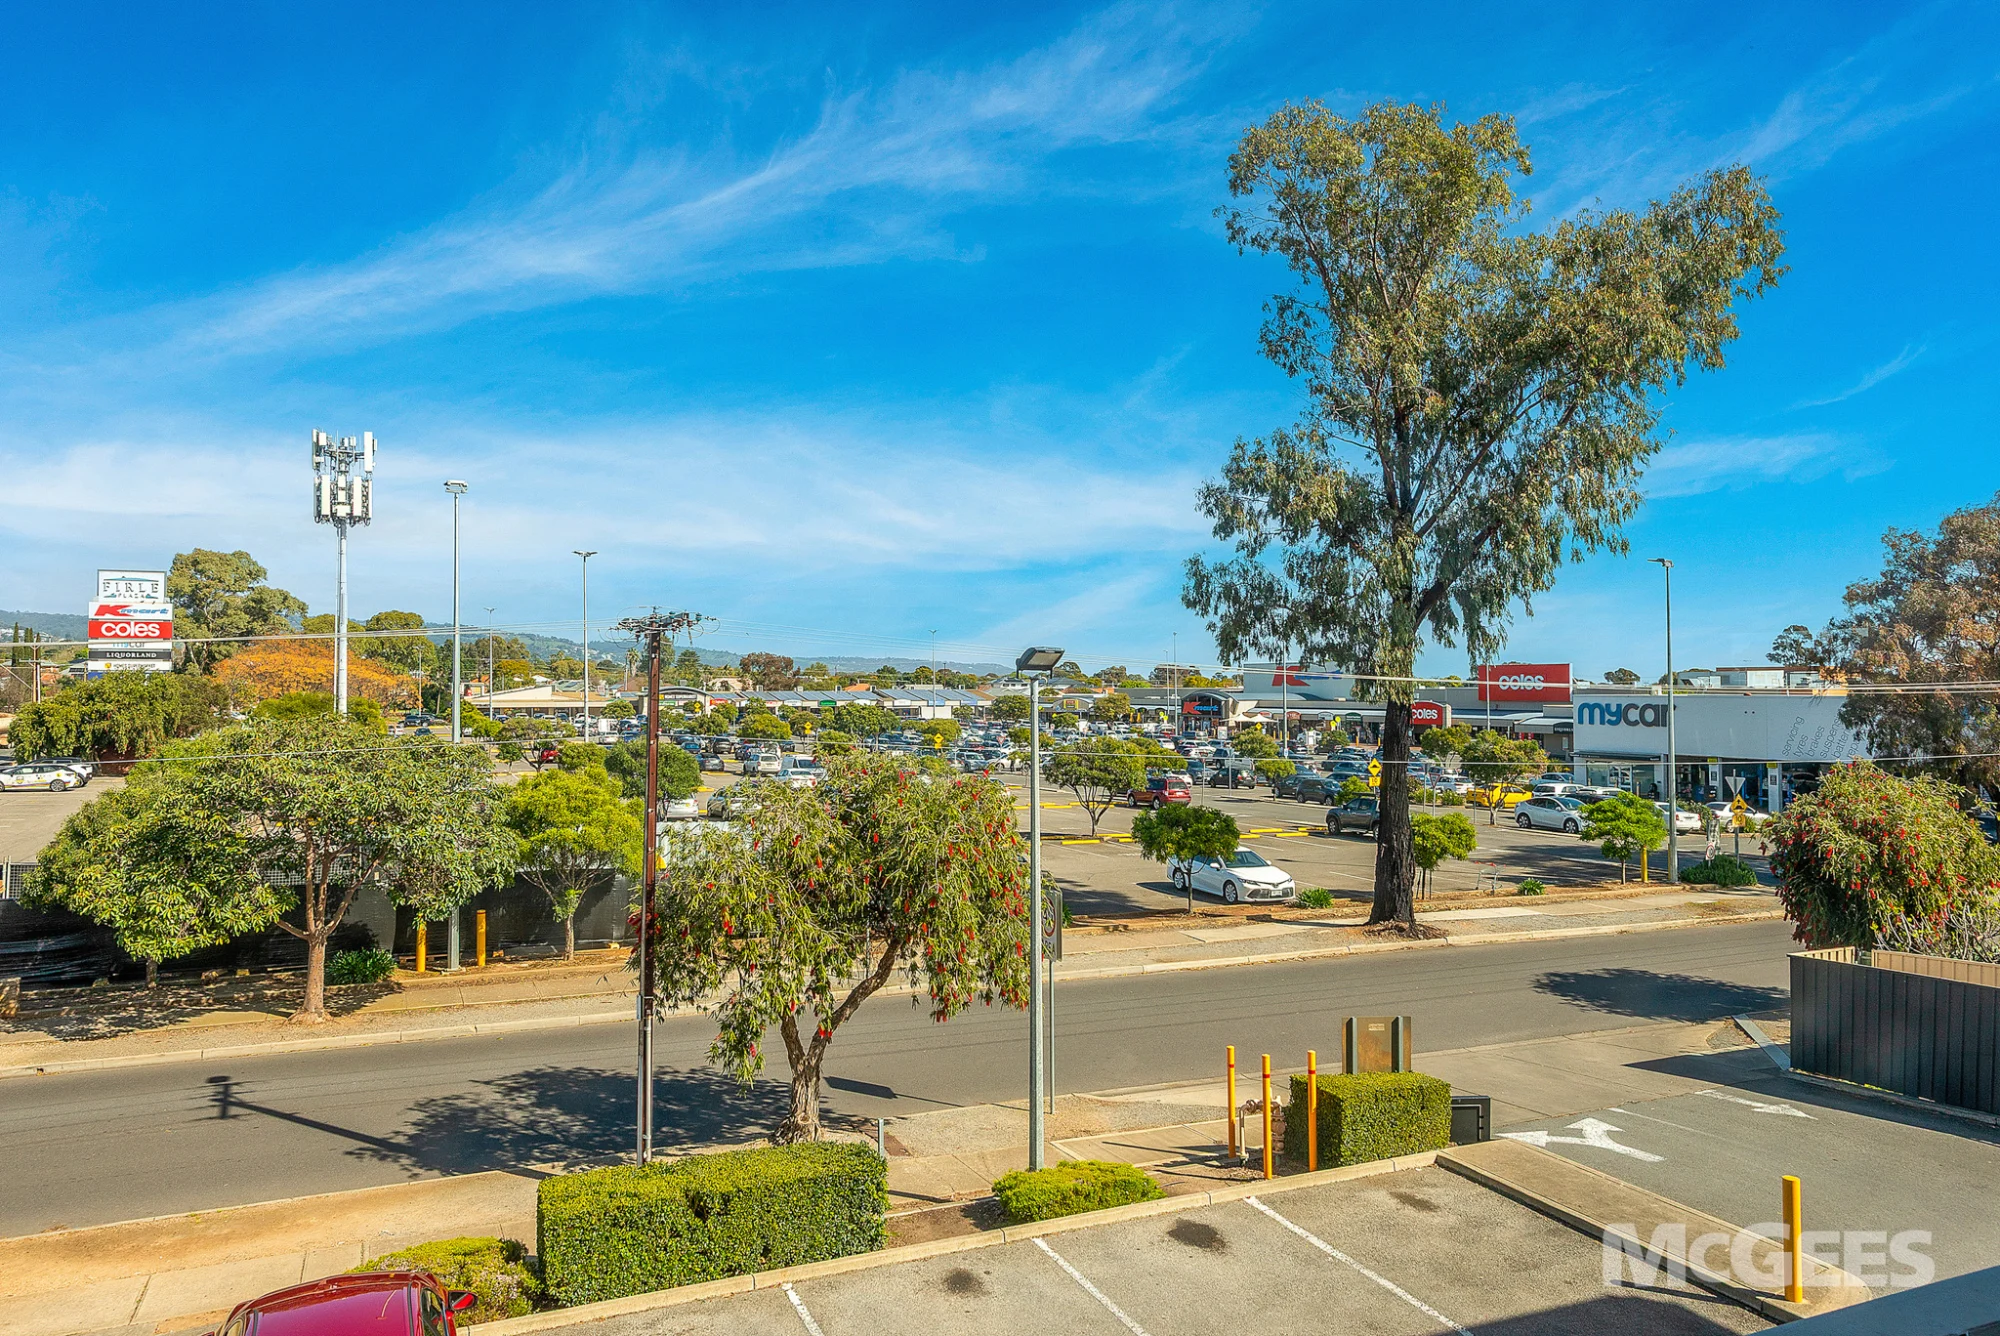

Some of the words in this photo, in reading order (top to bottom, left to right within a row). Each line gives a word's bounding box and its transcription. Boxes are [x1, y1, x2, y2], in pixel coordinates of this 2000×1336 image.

[103, 582, 159, 593] FIRLE
[94, 605, 169, 617] Kmart
[101, 621, 160, 637] coles
[1499, 674, 1545, 690] coles
[1182, 701, 1219, 715] Kmart
[1411, 708, 1438, 719] coles
[1578, 702, 1677, 728] mycar
[1782, 716, 1805, 757] servicing
[1805, 725, 1825, 757] brakes
[1793, 734, 1809, 758] tyres
